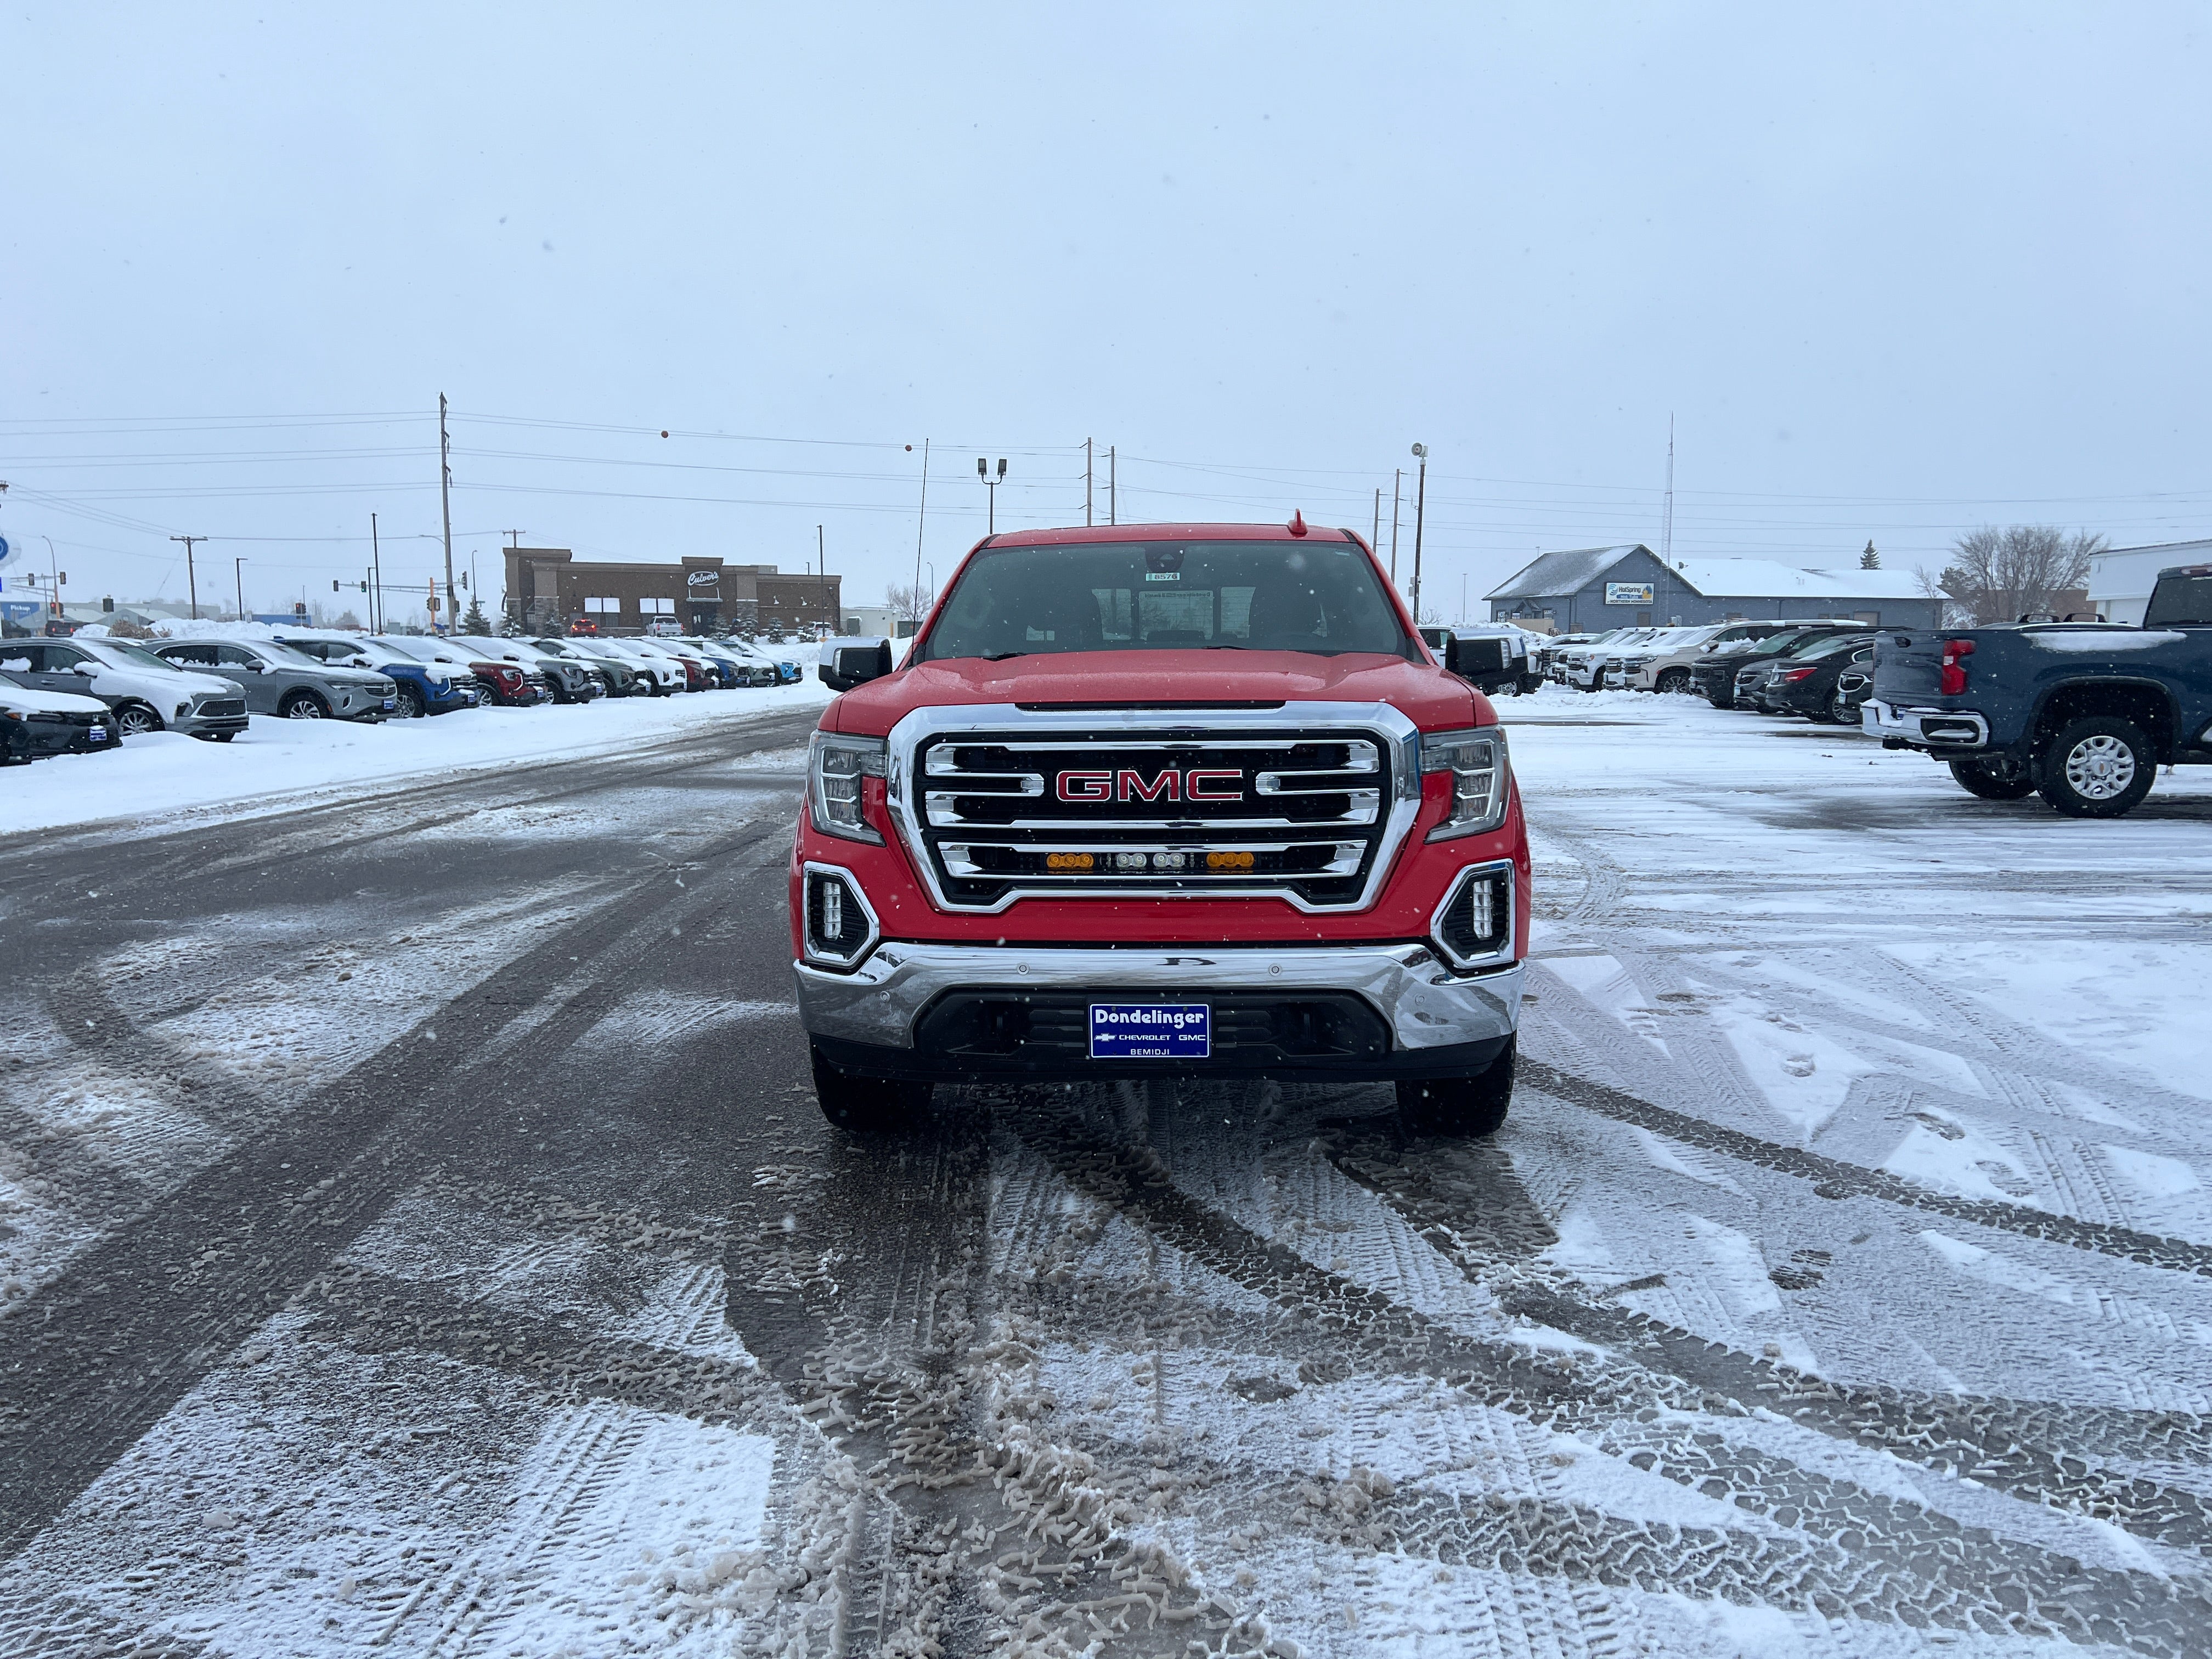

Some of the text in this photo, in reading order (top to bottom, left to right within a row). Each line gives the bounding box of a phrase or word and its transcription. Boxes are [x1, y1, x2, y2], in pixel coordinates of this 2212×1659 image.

[687, 571, 719, 586] Culver's
[1056, 769, 1243, 802] GMC
[1095, 1009, 1204, 1029] Dondelinger
